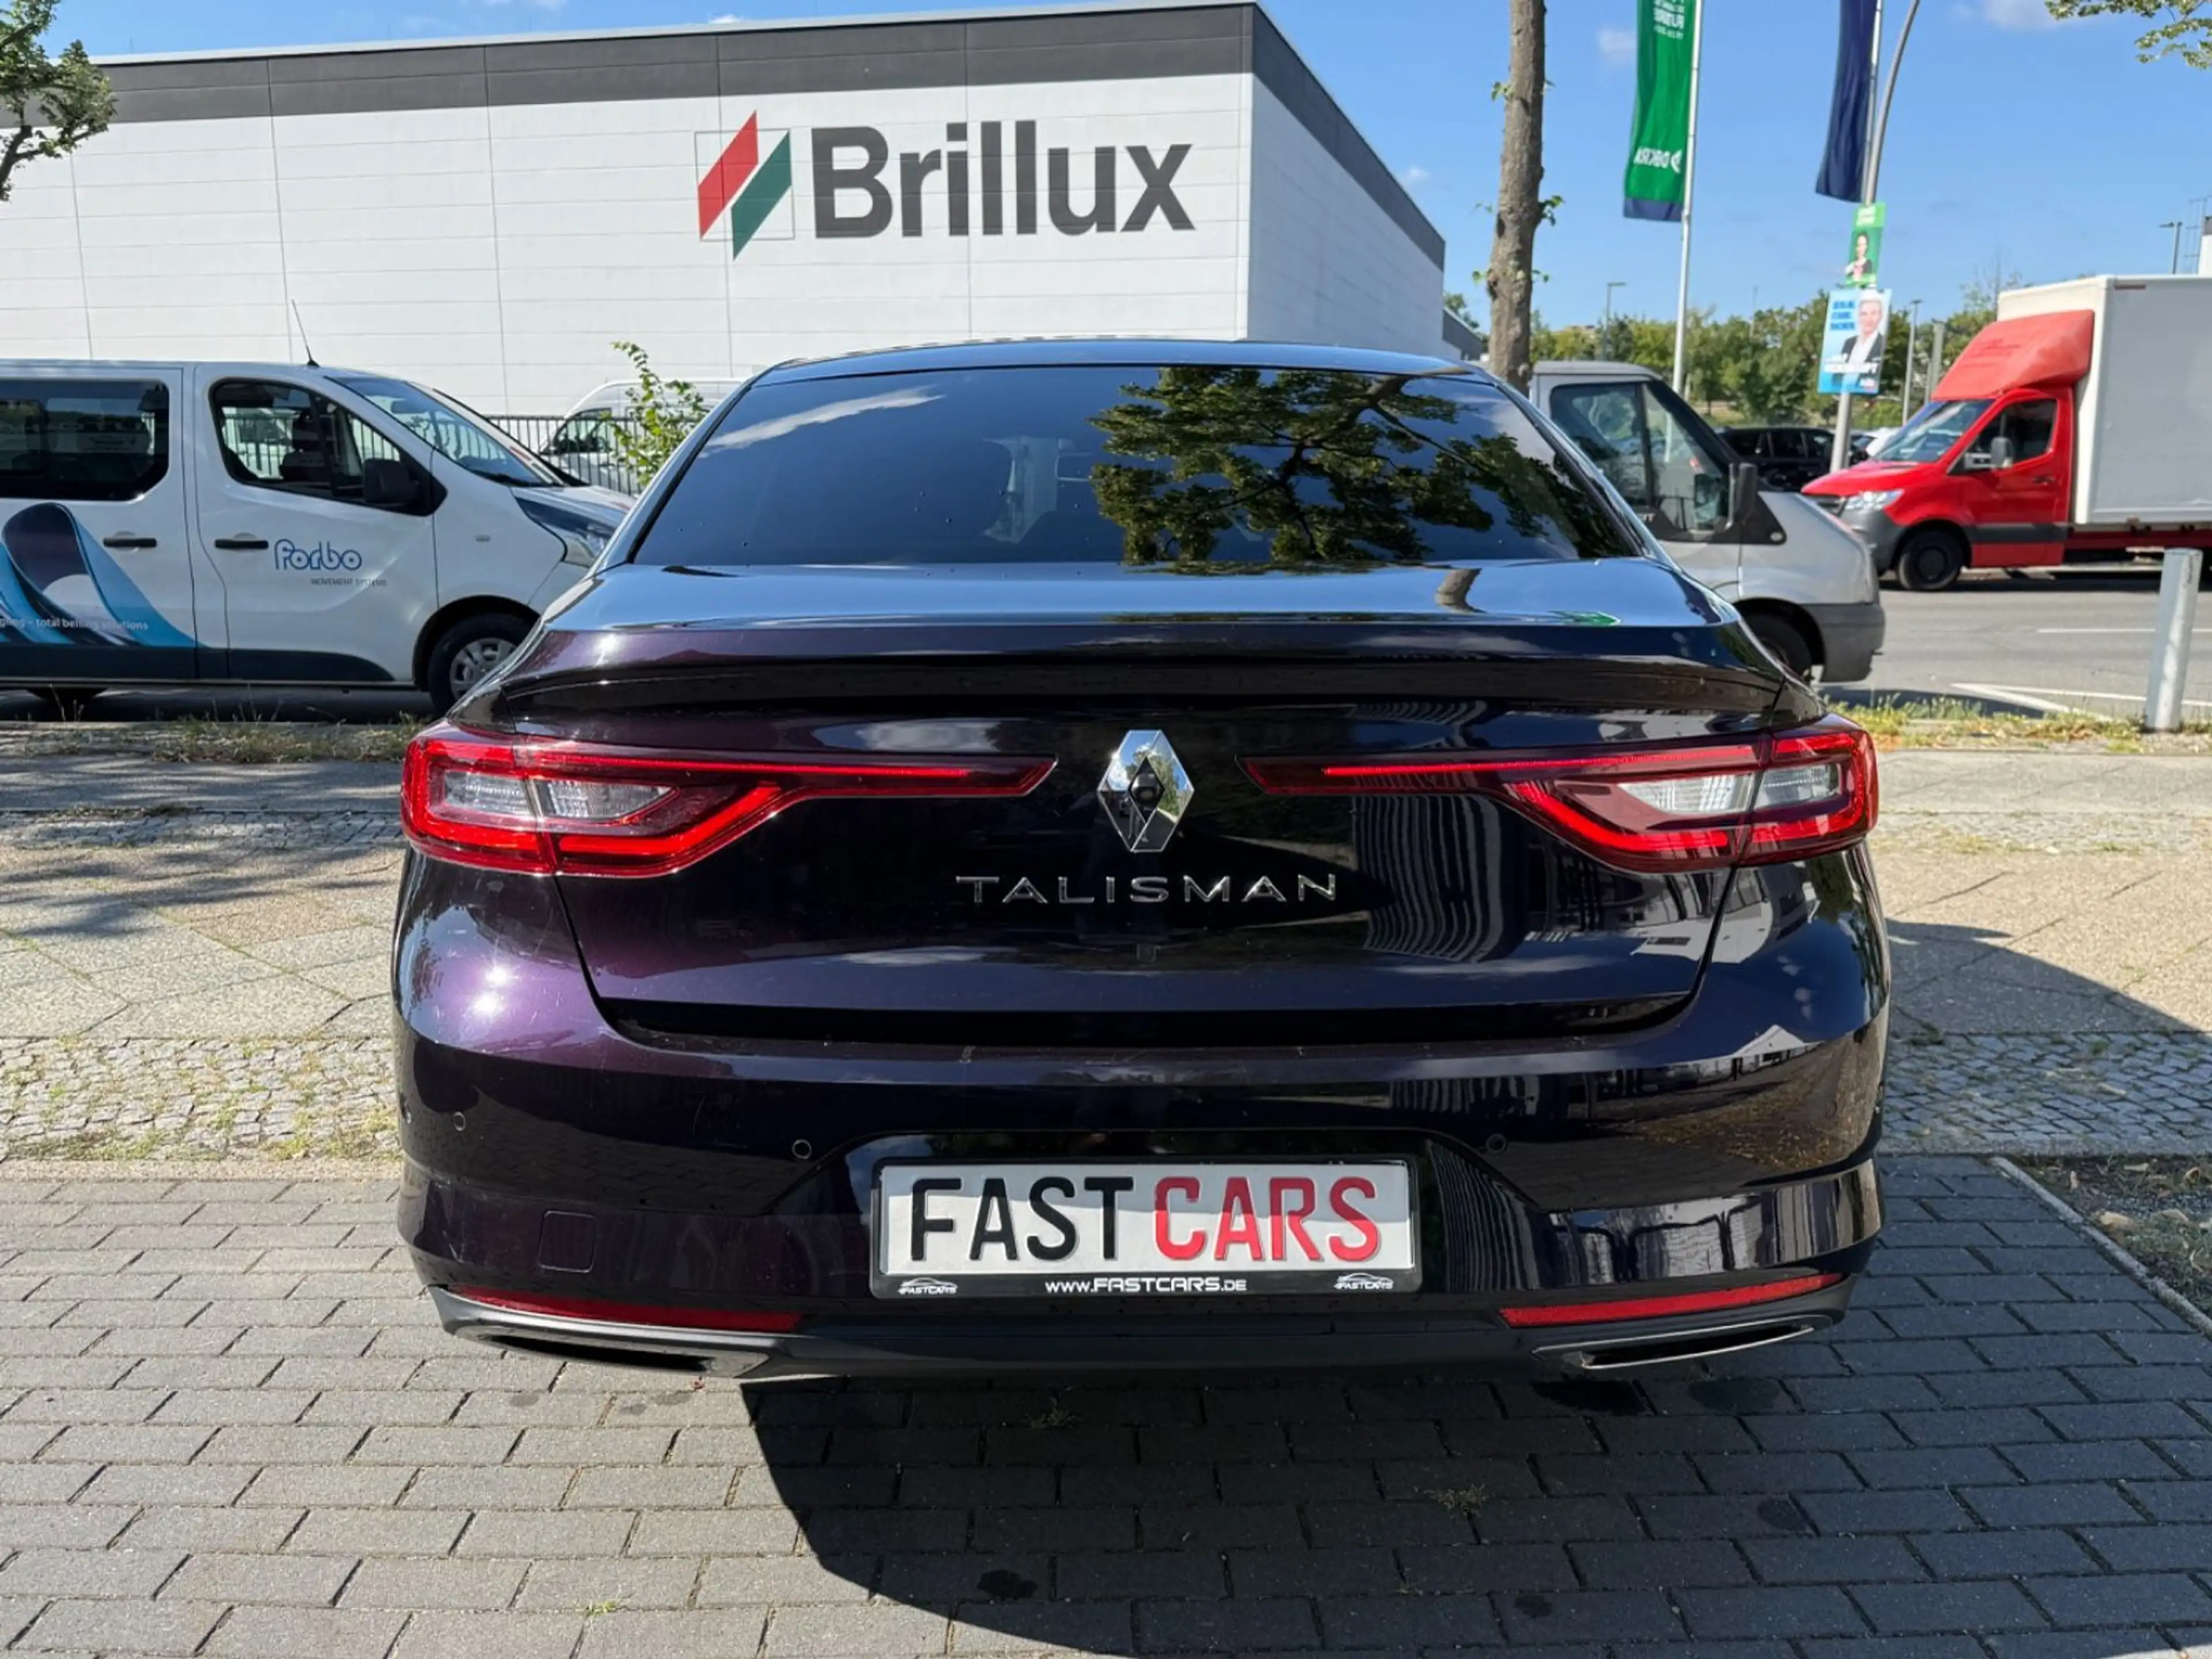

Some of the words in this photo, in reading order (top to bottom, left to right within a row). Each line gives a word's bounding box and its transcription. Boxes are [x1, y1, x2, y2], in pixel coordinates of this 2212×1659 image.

[811, 119, 1196, 238] Brillux
[311, 578, 353, 586] MOVEMENT
[36, 618, 60, 628] total
[62, 618, 99, 630] belng
[956, 874, 1336, 903] TALISMAN
[909, 1176, 1134, 1262] FAST
[1154, 1175, 1380, 1262] CARS
